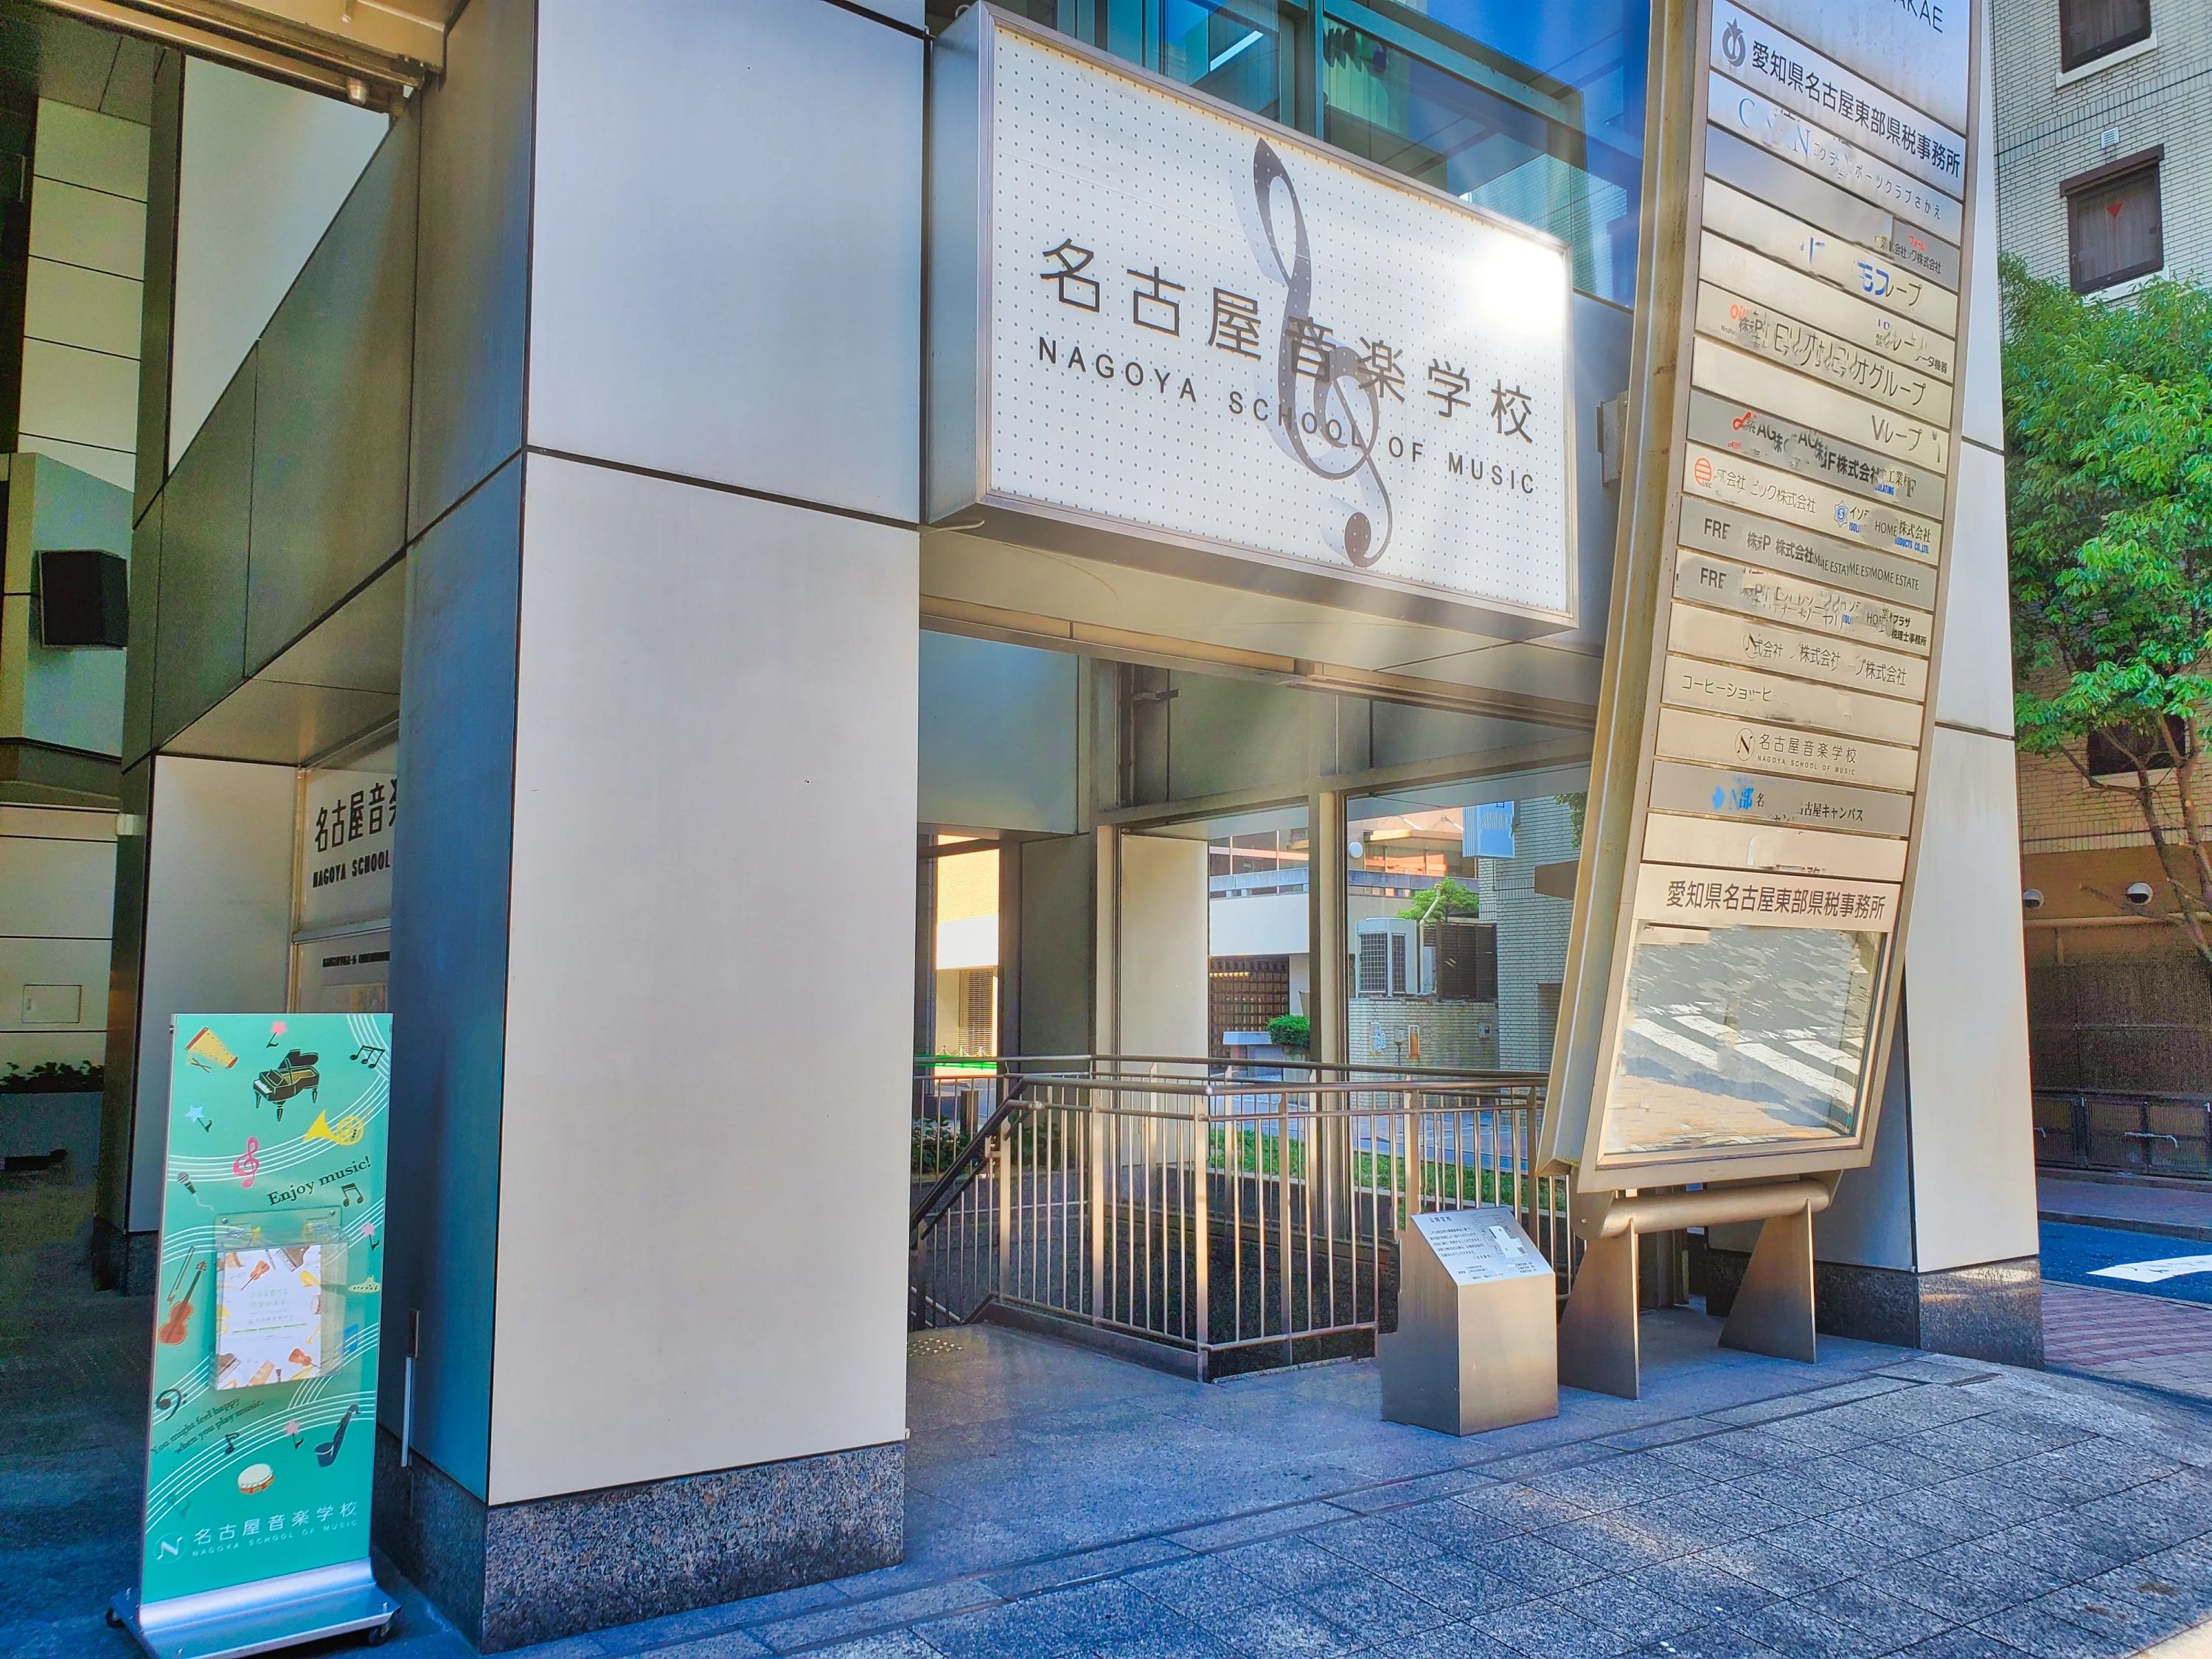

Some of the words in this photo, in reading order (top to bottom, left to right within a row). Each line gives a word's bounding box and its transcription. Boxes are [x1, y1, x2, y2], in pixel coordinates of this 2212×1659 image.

[1752, 40, 1961, 178] 愛知県名古屋東部県税事務所
[1040, 237, 1534, 444] 名古屋音楽学校
[1038, 336, 1197, 404] NAGOYA
[1228, 391, 1366, 450] SCHOOL
[1388, 435, 1425, 464] OF
[1447, 452, 1534, 495] MUSIC
[1757, 755, 1786, 765] NAGOYA
[1790, 760, 1818, 770] SCHOOL
[1834, 768, 1856, 776] MUSIC
[1759, 733, 1857, 764] 名古屋音楽学校
[312, 863, 347, 888] NAGOYA
[351, 849, 390, 877] SCHOOL
[1666, 880, 1887, 921] 愛知県名古屋東部県税事務所
[266, 1181, 315, 1207] Enjoy
[319, 1155, 372, 1186] music!
[192, 1502, 358, 1545] 名古屋音楽学校
[192, 1543, 239, 1557] NAGOYA
[323, 1520, 358, 1531] MUSIC
